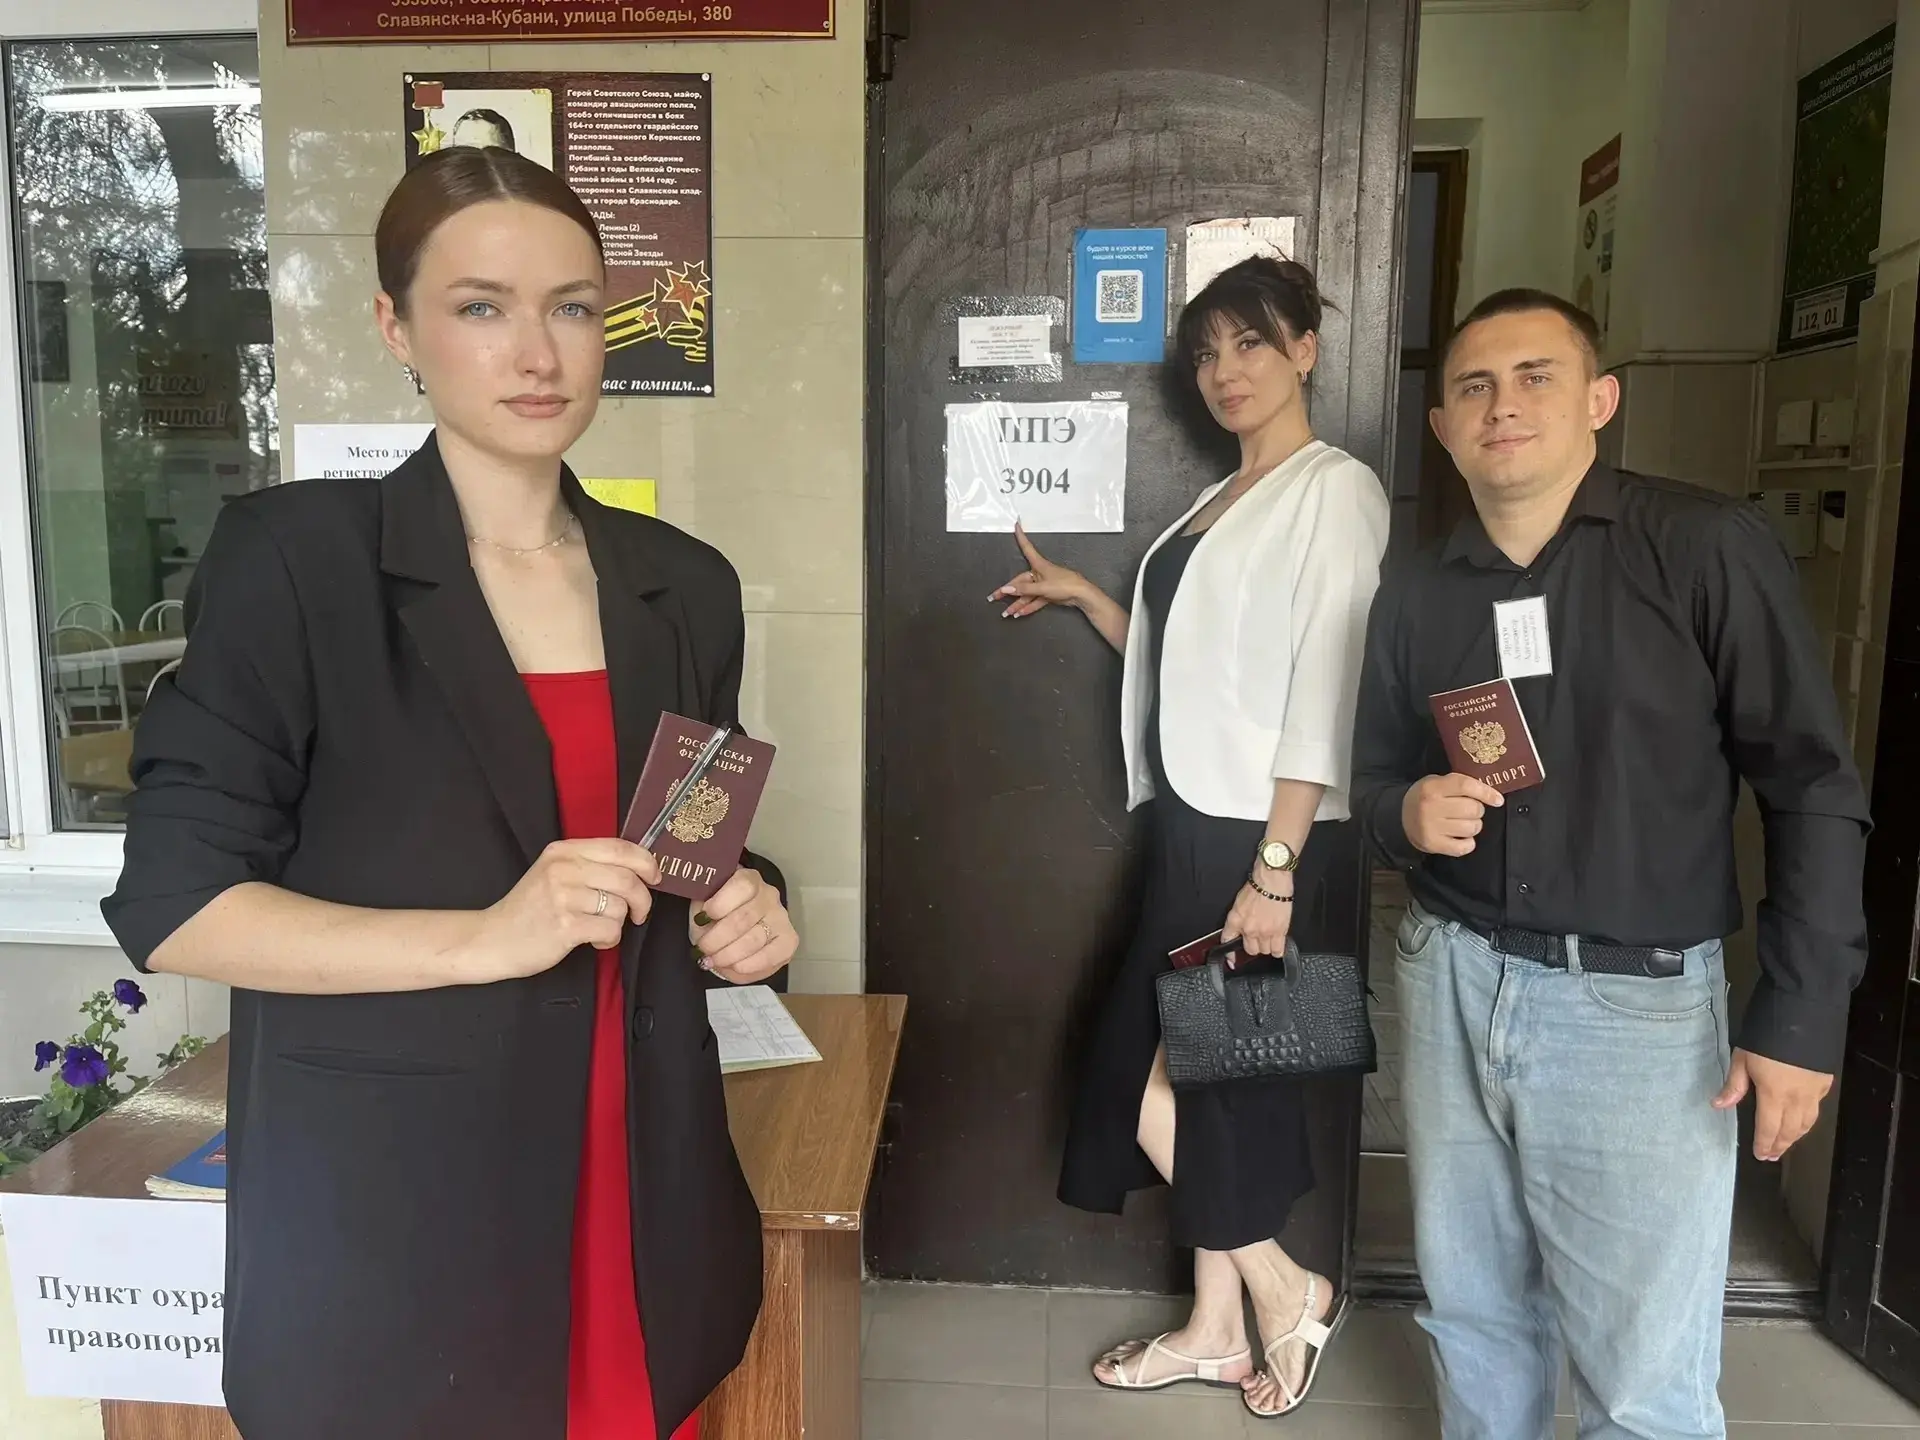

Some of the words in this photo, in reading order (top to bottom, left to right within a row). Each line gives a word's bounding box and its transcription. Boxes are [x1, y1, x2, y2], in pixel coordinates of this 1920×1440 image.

[377, 9, 559, 28] Славянск-на-Кубани,
[563, 10, 617, 27] улица
[621, 7, 697, 23] Победы,
[702, 6, 733, 21] 380
[567, 89, 592, 97] Герой
[593, 90, 640, 98] Советского
[641, 90, 672, 99] Союза,
[673, 91, 702, 99] майор,
[567, 101, 608, 109] командир
[665, 112, 685, 120] боях
[595, 123, 642, 131] отдельного
[643, 123, 699, 131] гвардейского
[568, 133, 647, 141] Краснознаменного
[648, 134, 702, 142] Керченского
[624, 155, 684, 163] освобождение
[569, 165, 599, 173] Кубани
[629, 198, 681, 206] Краснодаре.
[629, 223, 640, 232] (2)
[1825, 307, 1838, 325] 01
[602, 380, 628, 390] вас
[631, 380, 704, 391] помним...
[998, 416, 1076, 444] ППЭ
[347, 446, 389, 458] Место
[1000, 468, 1070, 494] 3904
[1443, 693, 1498, 711] РОССИЙСКАЯ
[1449, 702, 1497, 718] ФЕДЕРАЦИЯ
[678, 735, 753, 765] РОСССКАЯ
[1479, 764, 1526, 787] СПОРТ
[653, 852, 717, 885] СПОРТ
[36, 1275, 142, 1308] Пункт
[47, 1327, 222, 1359] правопоря
